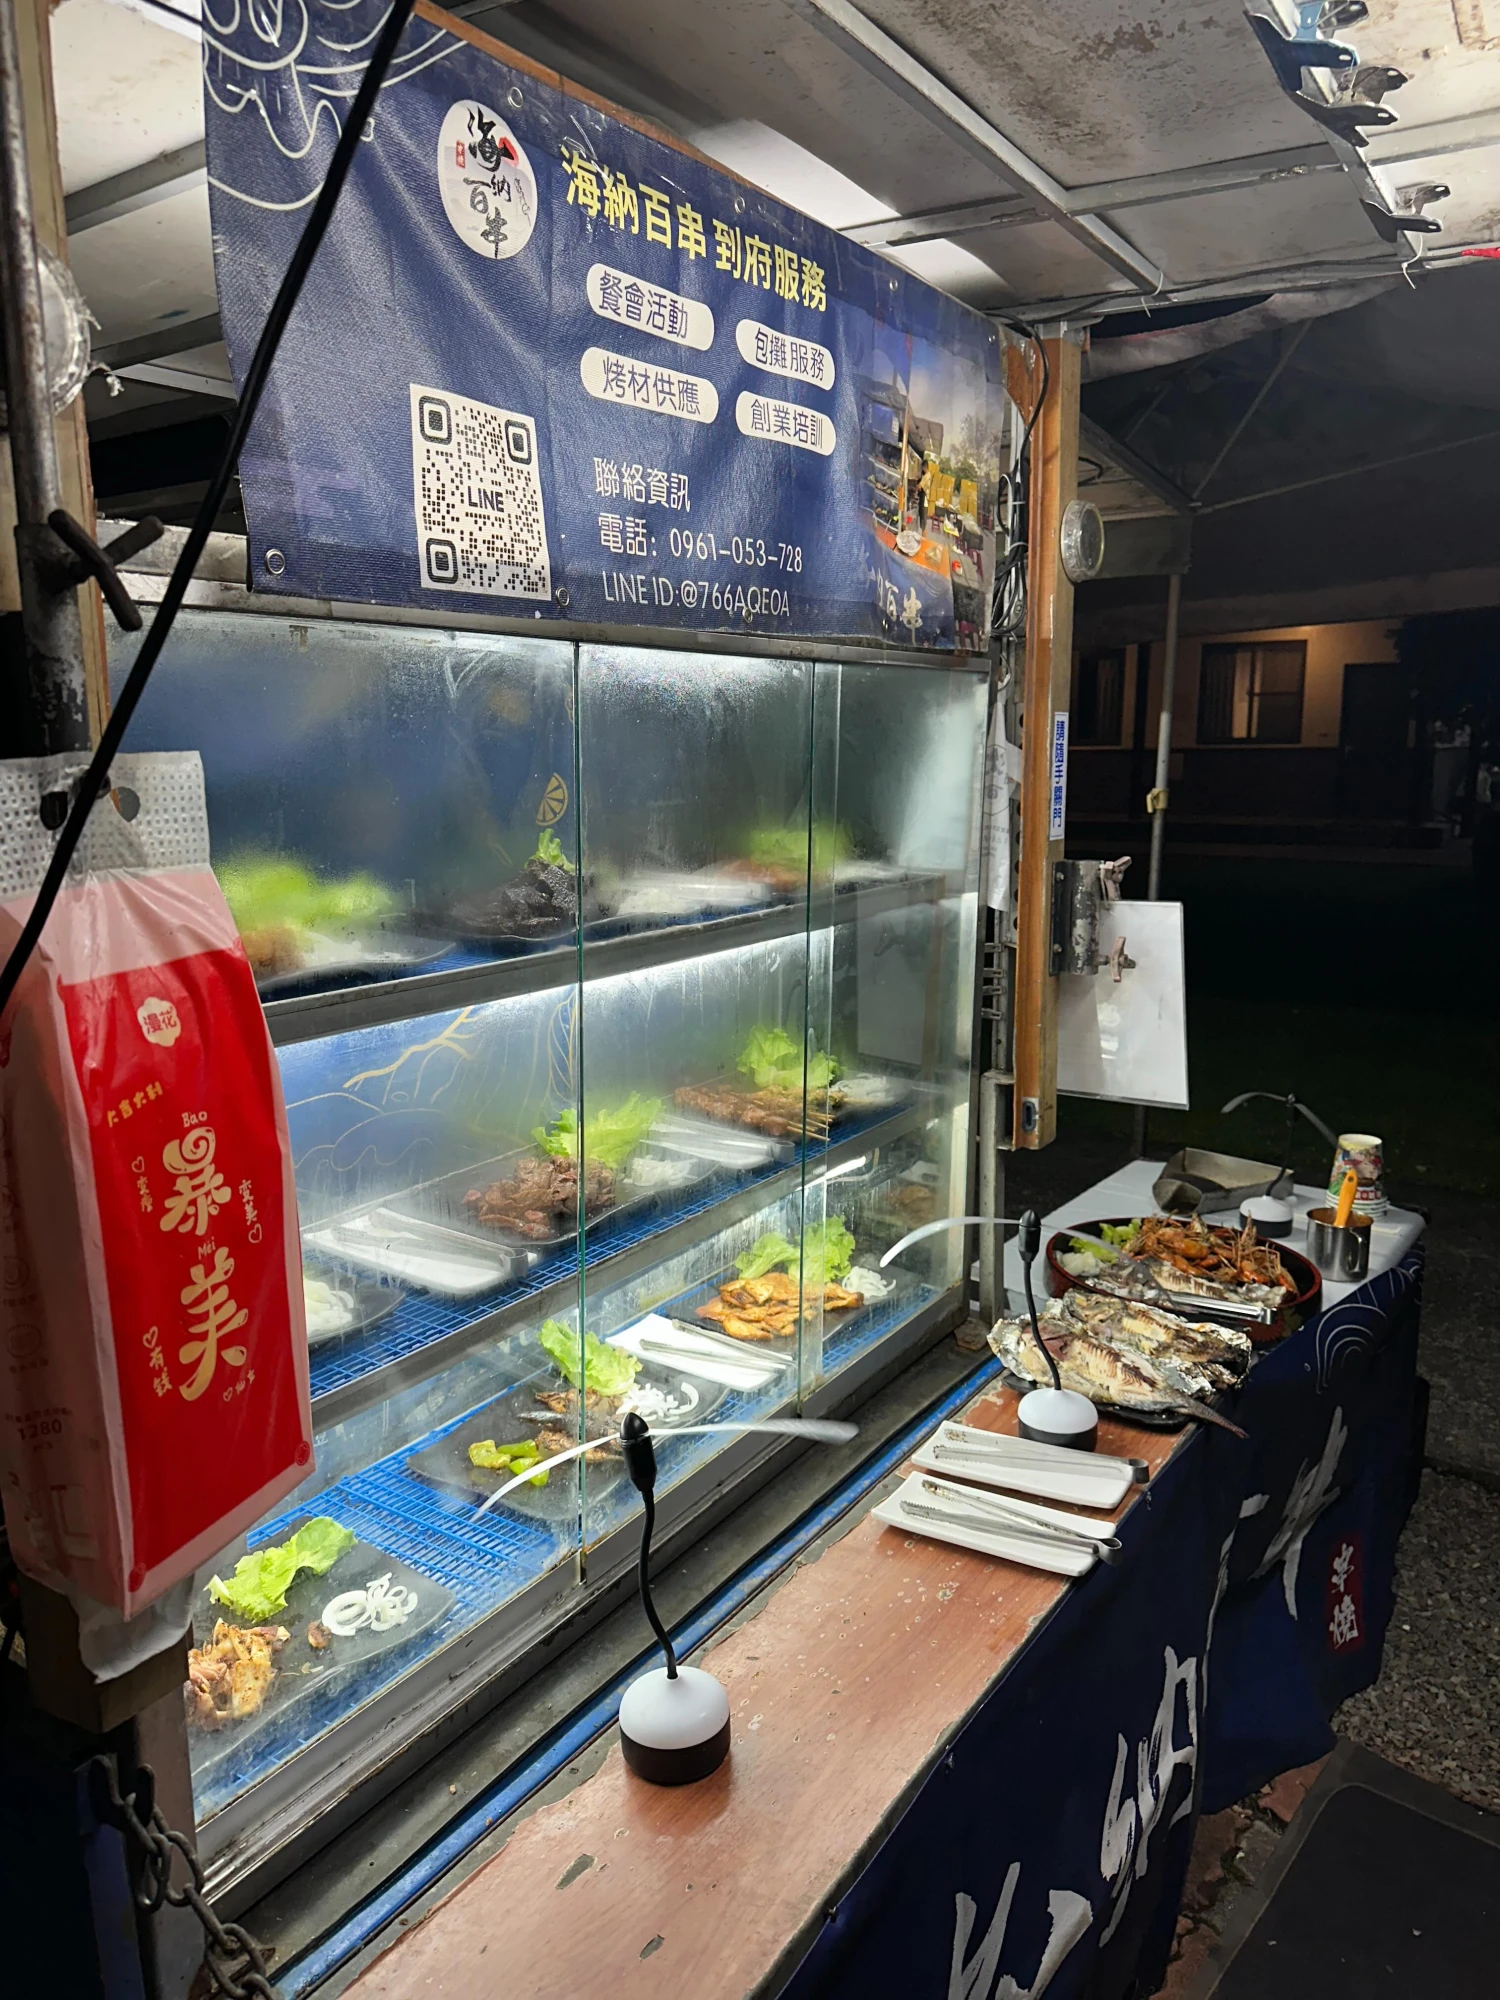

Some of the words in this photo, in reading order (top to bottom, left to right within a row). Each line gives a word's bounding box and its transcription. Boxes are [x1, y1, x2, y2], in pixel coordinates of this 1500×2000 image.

[559, 144, 707, 260] 海納百串
[712, 218, 827, 312] 到府服務
[598, 270, 688, 340] 餐會活動
[754, 327, 825, 382] 包攤服務
[602, 355, 701, 415] 烤材供應
[750, 398, 823, 448] 創業培訓
[467, 485, 505, 513] LINE
[593, 457, 691, 512] 聯絡資訊
[669, 527, 803, 573] 0961-053-728
[602, 570, 649, 605] LINE
[1053, 720, 1066, 829] 請隨手關門
[142, 1012, 177, 1035] 漫花
[239, 1179, 258, 1226] 变美
[149, 1345, 173, 1398] 有钱
[17, 1418, 63, 1441] 1280
[1328, 1542, 1360, 1650] 串燒
